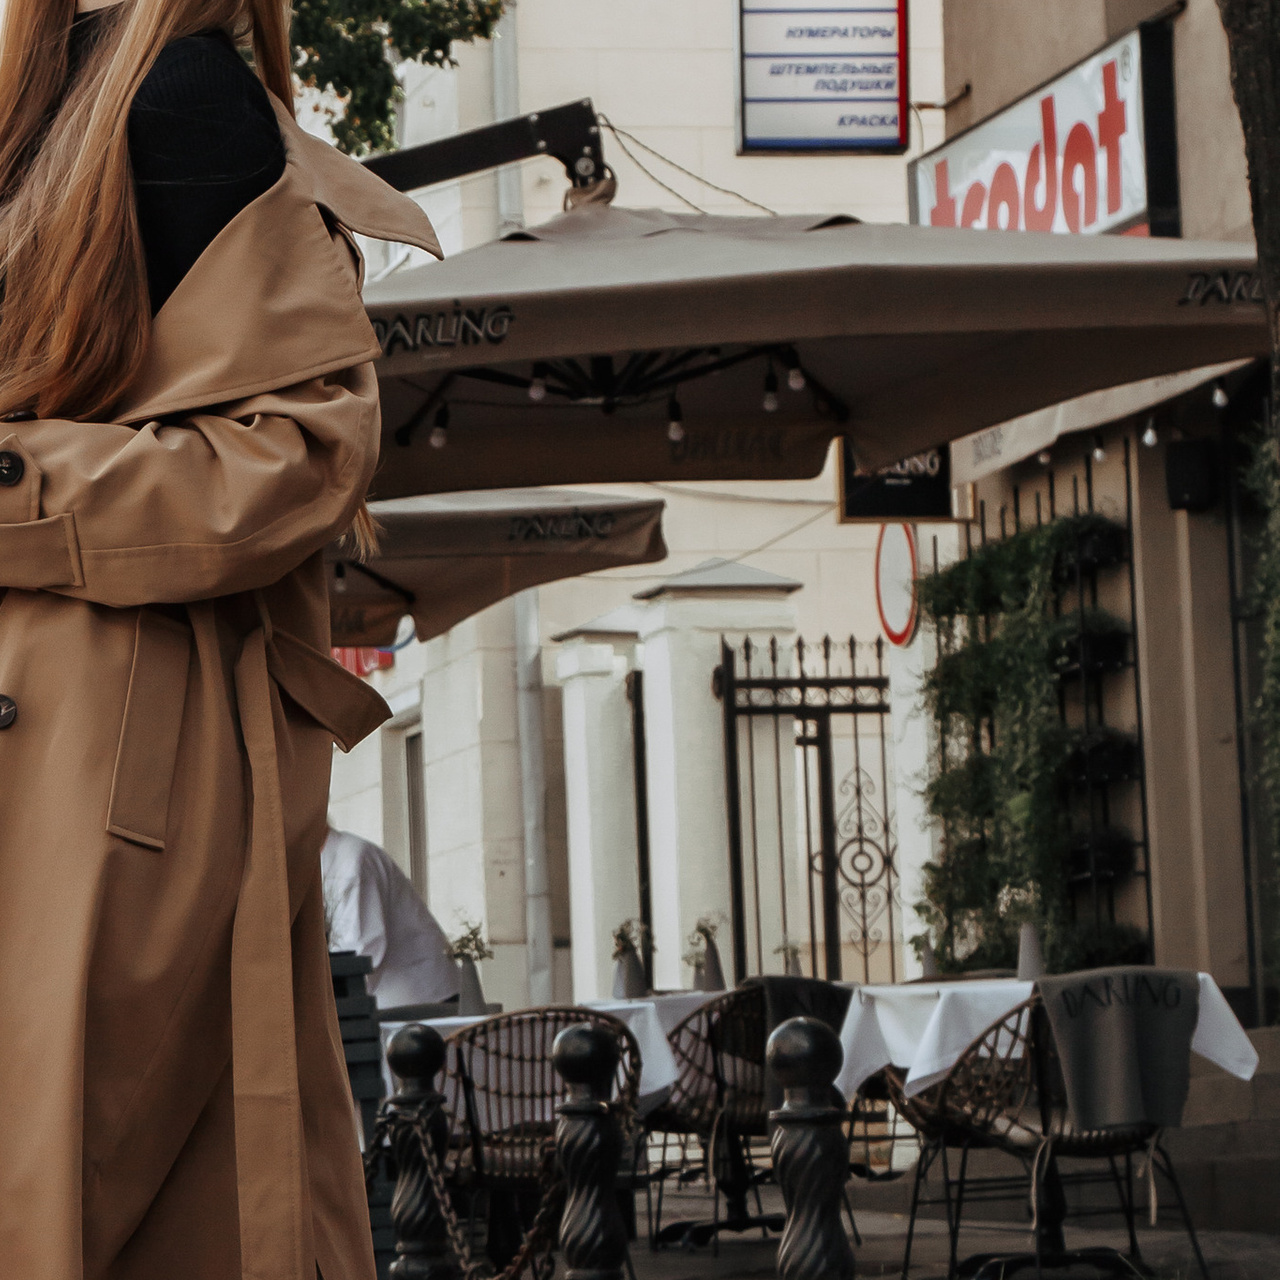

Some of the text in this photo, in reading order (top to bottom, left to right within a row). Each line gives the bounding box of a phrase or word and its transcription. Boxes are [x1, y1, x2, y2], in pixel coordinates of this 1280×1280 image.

[785, 26, 895, 39] НУМЕРАТОРЫ
[769, 63, 896, 75] ШТЕМПЕЛЬНЫЕ
[814, 78, 896, 92] ПОДУШКИ
[837, 114, 899, 128] КРАСКА
